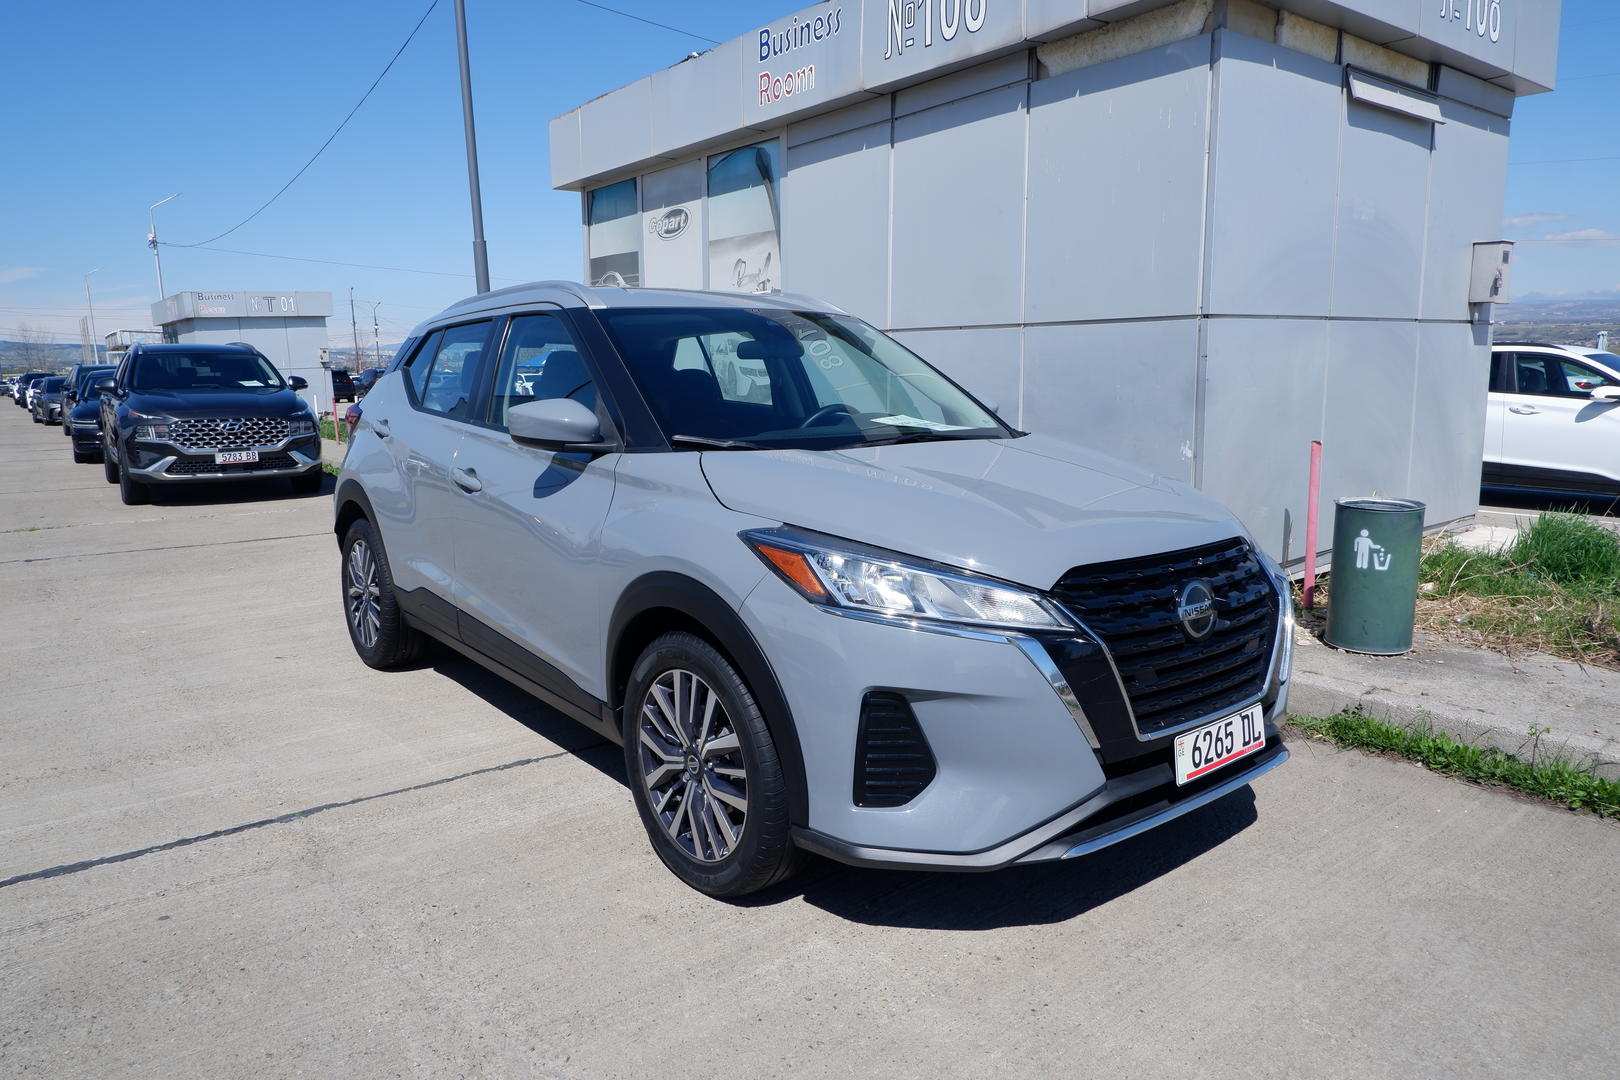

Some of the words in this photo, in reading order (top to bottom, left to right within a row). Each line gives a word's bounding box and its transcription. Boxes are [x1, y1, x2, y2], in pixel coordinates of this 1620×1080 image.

[759, 7, 842, 63] Business
[759, 64, 815, 106] Room
[649, 209, 687, 234] Copart
[197, 292, 234, 301] Business
[221, 452, 243, 461] 5783
[246, 451, 257, 460] BB
[1191, 720, 1234, 769] 6265
[1239, 711, 1261, 747] DL
